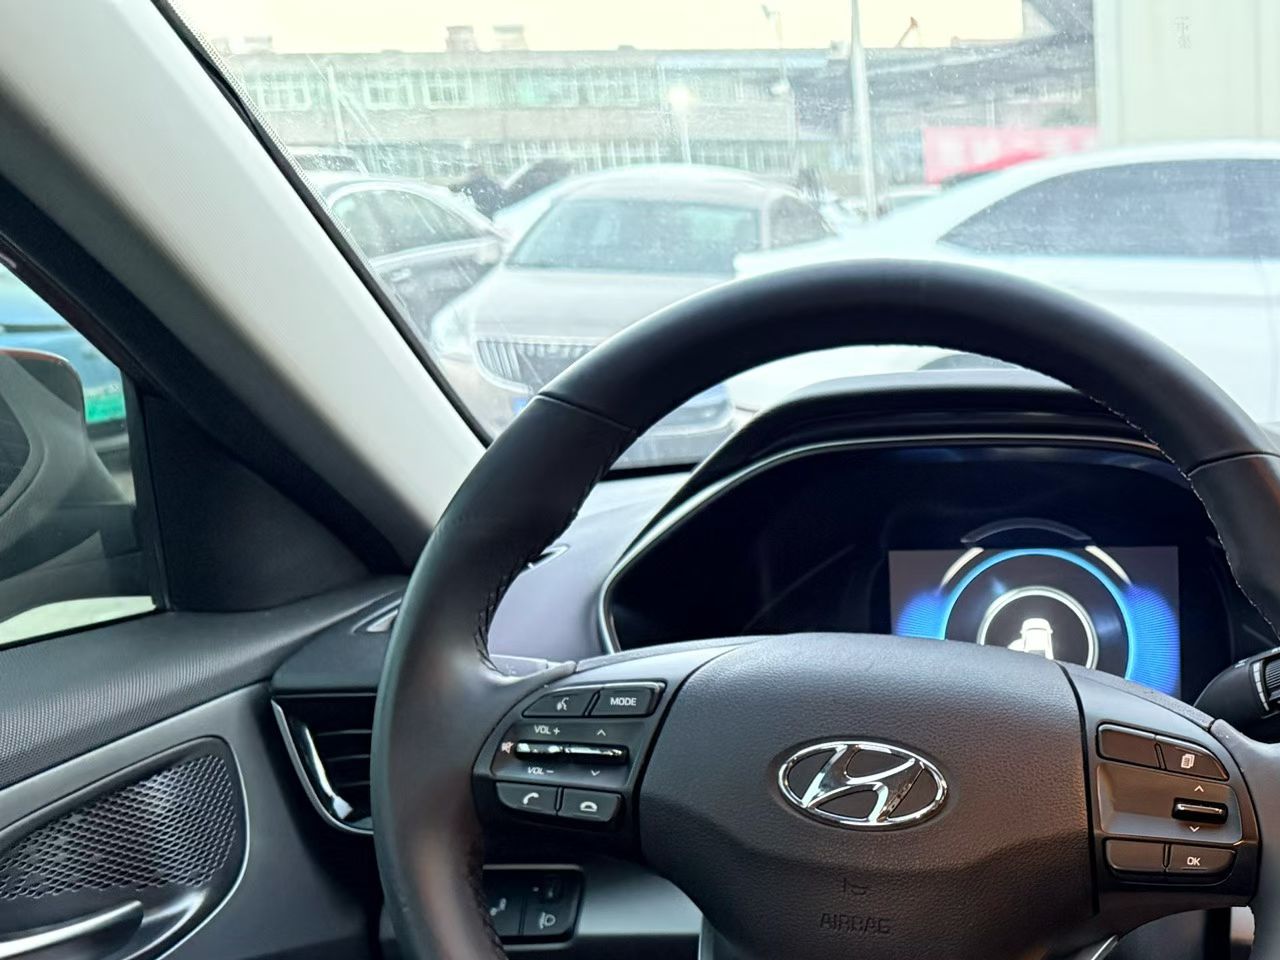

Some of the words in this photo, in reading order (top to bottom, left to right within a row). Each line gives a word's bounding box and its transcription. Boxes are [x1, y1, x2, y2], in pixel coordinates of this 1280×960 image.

[610, 696, 638, 706] MODE
[533, 724, 551, 735] VOL
[527, 766, 545, 775] VOL
[1186, 856, 1201, 866] OK
